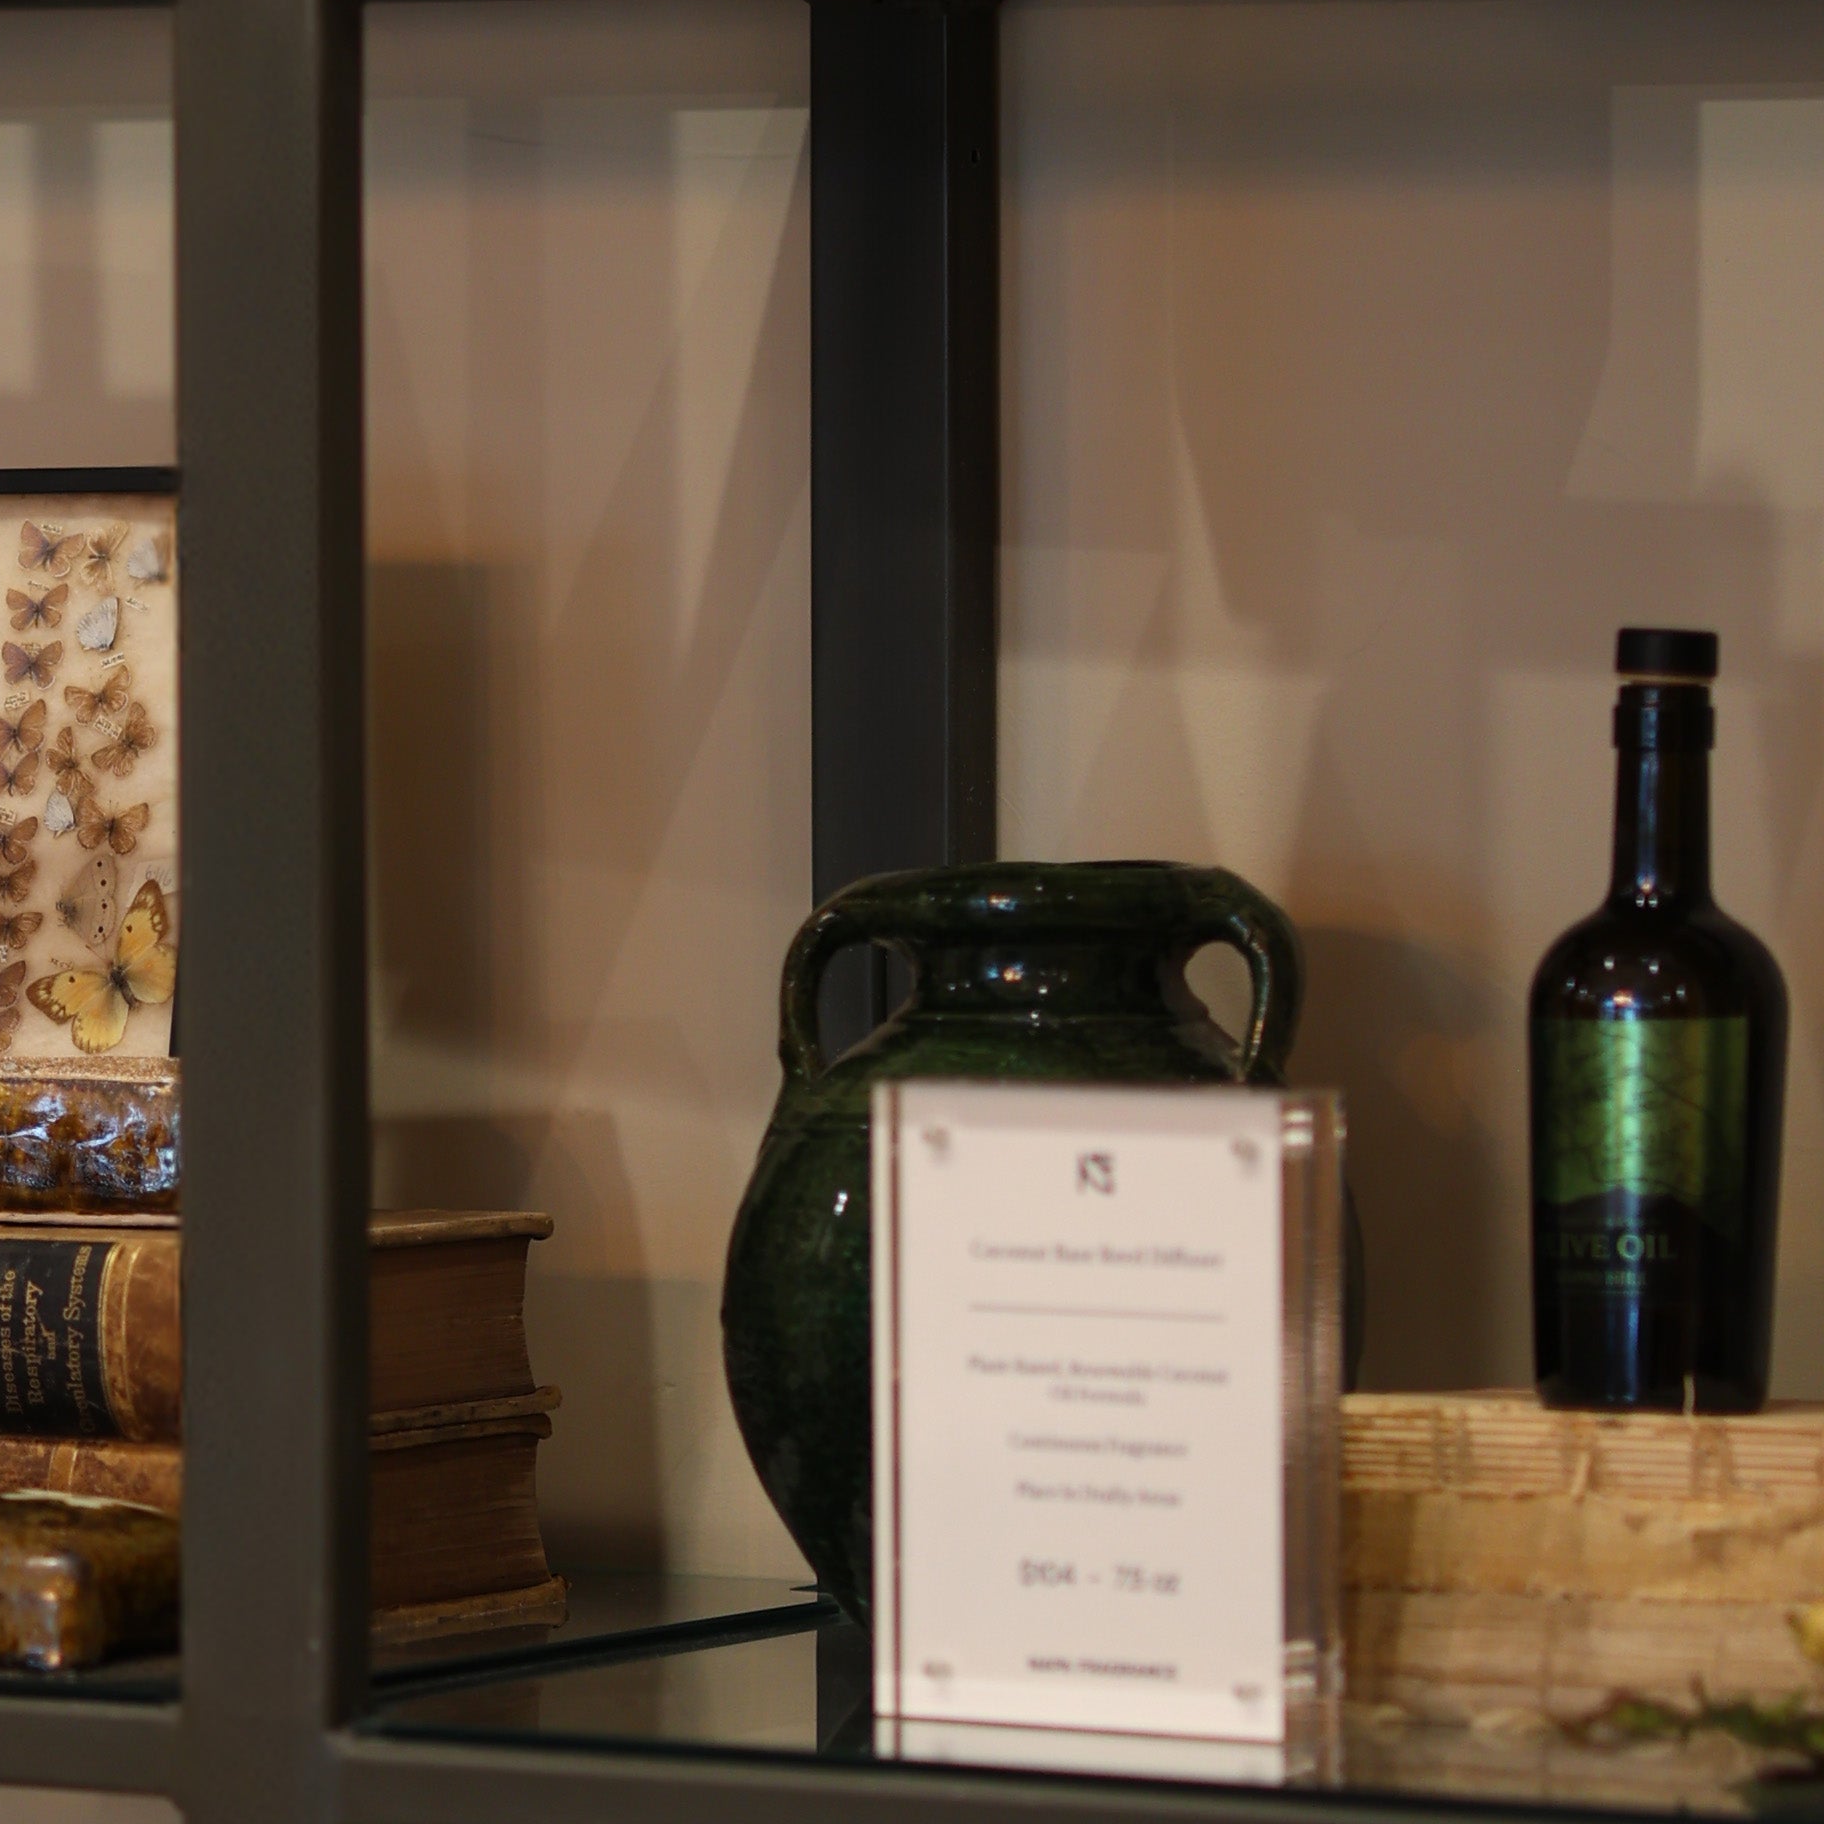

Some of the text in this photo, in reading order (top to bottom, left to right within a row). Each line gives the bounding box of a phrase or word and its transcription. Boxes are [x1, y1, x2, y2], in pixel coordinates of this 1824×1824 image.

[63, 1245, 93, 1321] Systems
[1616, 1233, 1679, 1262] OIL
[0, 1327, 22, 1414] Diseases
[22, 1280, 45, 1405] Respiratory
